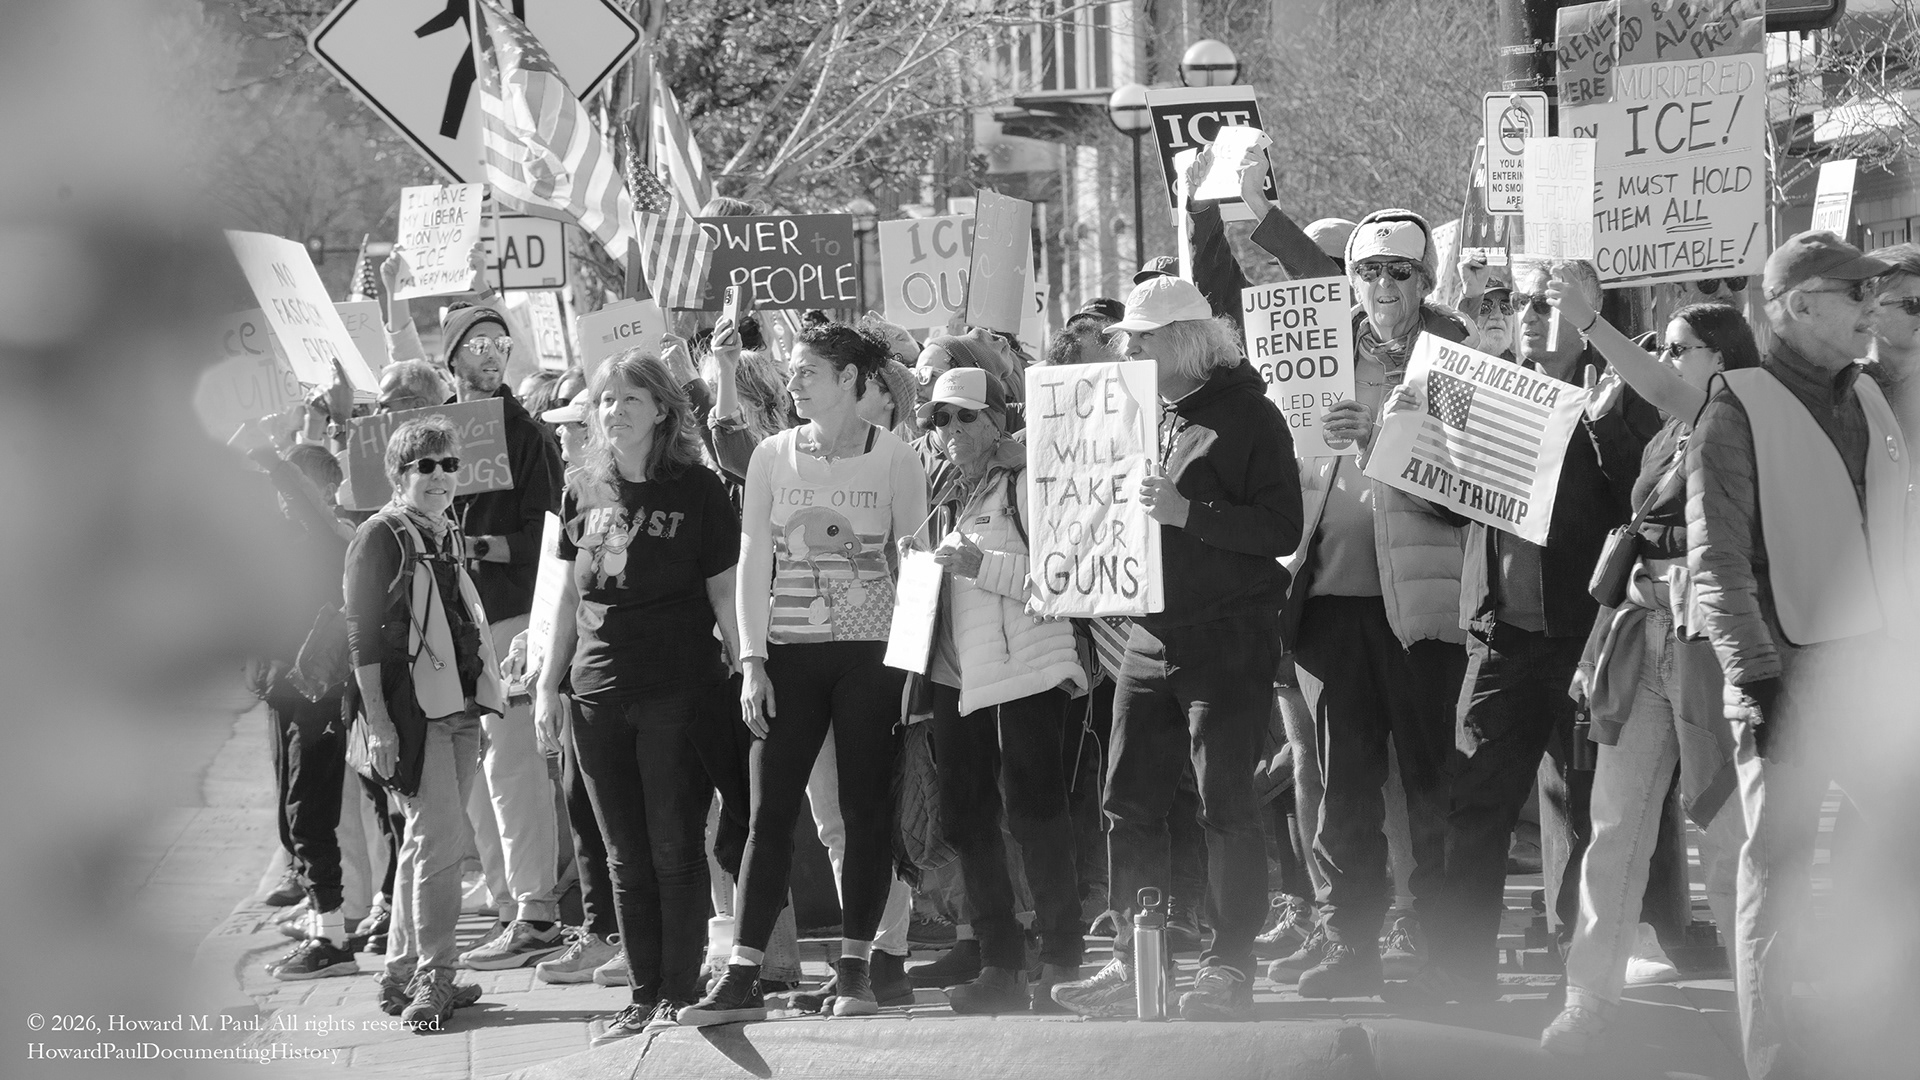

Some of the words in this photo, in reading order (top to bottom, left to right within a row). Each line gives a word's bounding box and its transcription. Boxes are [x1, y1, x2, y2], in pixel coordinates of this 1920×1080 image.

[1558, 10, 1625, 70] RENEE
[1593, 16, 1643, 74] GOOD
[1656, 2, 1709, 58] ALE
[1616, 60, 1756, 101] MURDERED
[1624, 94, 1745, 157] ICE!
[1492, 172, 1524, 180] ENTERIN
[1500, 159, 1515, 168] YOU
[1534, 142, 1588, 181] LOVE
[432, 187, 468, 207] HAVE
[1492, 184, 1503, 193] NO
[1618, 173, 1679, 199] MUST
[1693, 165, 1752, 195] HOLD
[1536, 184, 1584, 221] THY
[1593, 204, 1651, 233] THEM
[1662, 197, 1709, 226] ALL
[405, 230, 431, 247] TION
[436, 228, 462, 246] W/O
[480, 235, 545, 270] EAD
[699, 219, 803, 256] OWER
[811, 232, 841, 256] to
[1525, 221, 1594, 259] NEIGHBOR
[1596, 222, 1759, 275] COUNTABLE!
[416, 245, 447, 270] ICE
[271, 262, 297, 289] NO
[418, 270, 440, 285] VERY
[441, 267, 470, 284] MUCH!
[729, 263, 857, 304] PEOPLE
[902, 268, 969, 316] OU
[1245, 283, 1342, 313] JUSTICE
[613, 320, 643, 340] ICE
[1270, 306, 1318, 331] FOR
[1256, 328, 1338, 358] RENEE
[1259, 355, 1339, 385] GOOD
[1432, 346, 1562, 409] PRO-AMERICA
[1040, 377, 1120, 420] ICE
[1052, 436, 1126, 465] WILL
[779, 487, 815, 506] ICE
[831, 490, 878, 509] OUT!
[1035, 473, 1129, 507] TAKE
[1401, 456, 1529, 526] ANTI-TRUMP
[1047, 519, 1127, 549] YOUR
[1043, 551, 1140, 600] GUNS
